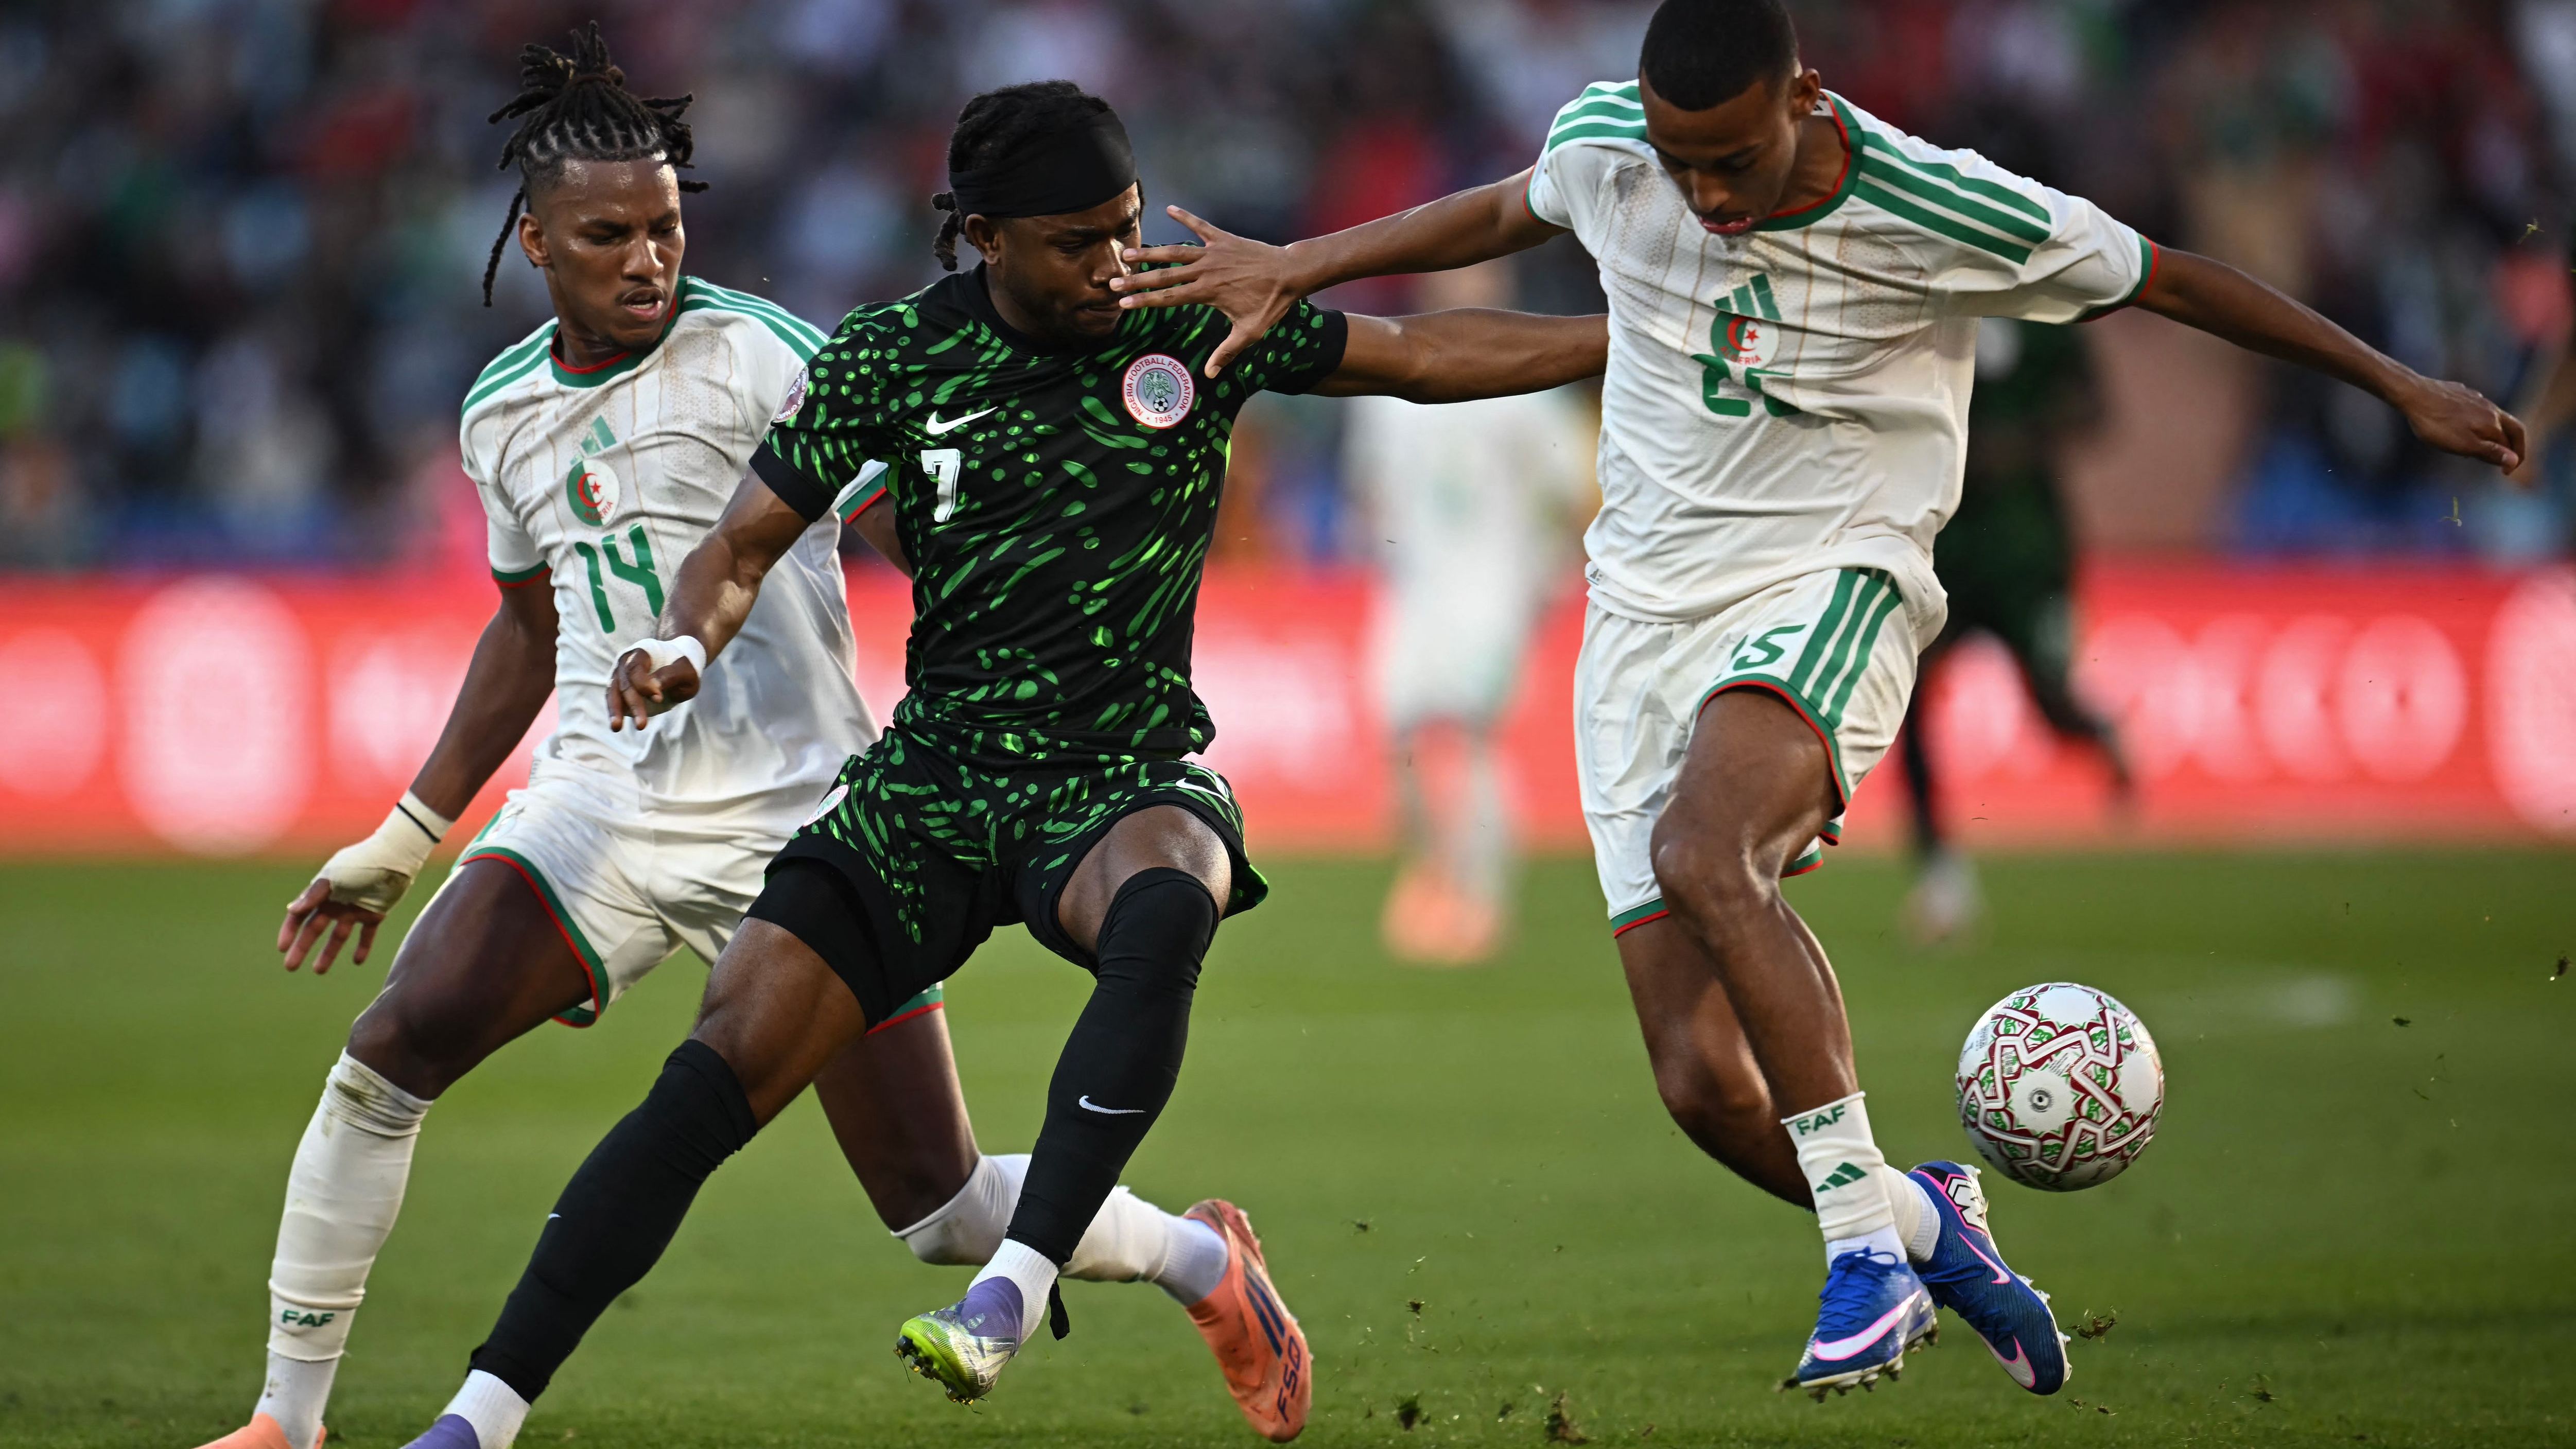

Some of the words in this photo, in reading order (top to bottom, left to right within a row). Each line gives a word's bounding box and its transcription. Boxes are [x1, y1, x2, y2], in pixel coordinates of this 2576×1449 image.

[1129, 358, 1166, 381] FOOTBALL
[1126, 383, 1143, 416] NIGERIA
[1168, 361, 1190, 411] FEDERATION
[1155, 414, 1173, 424] 1945
[920, 448, 961, 523] 7
[575, 523, 665, 634] 14
[1796, 1104, 1846, 1136] FAF
[282, 1310, 335, 1328] FAF
